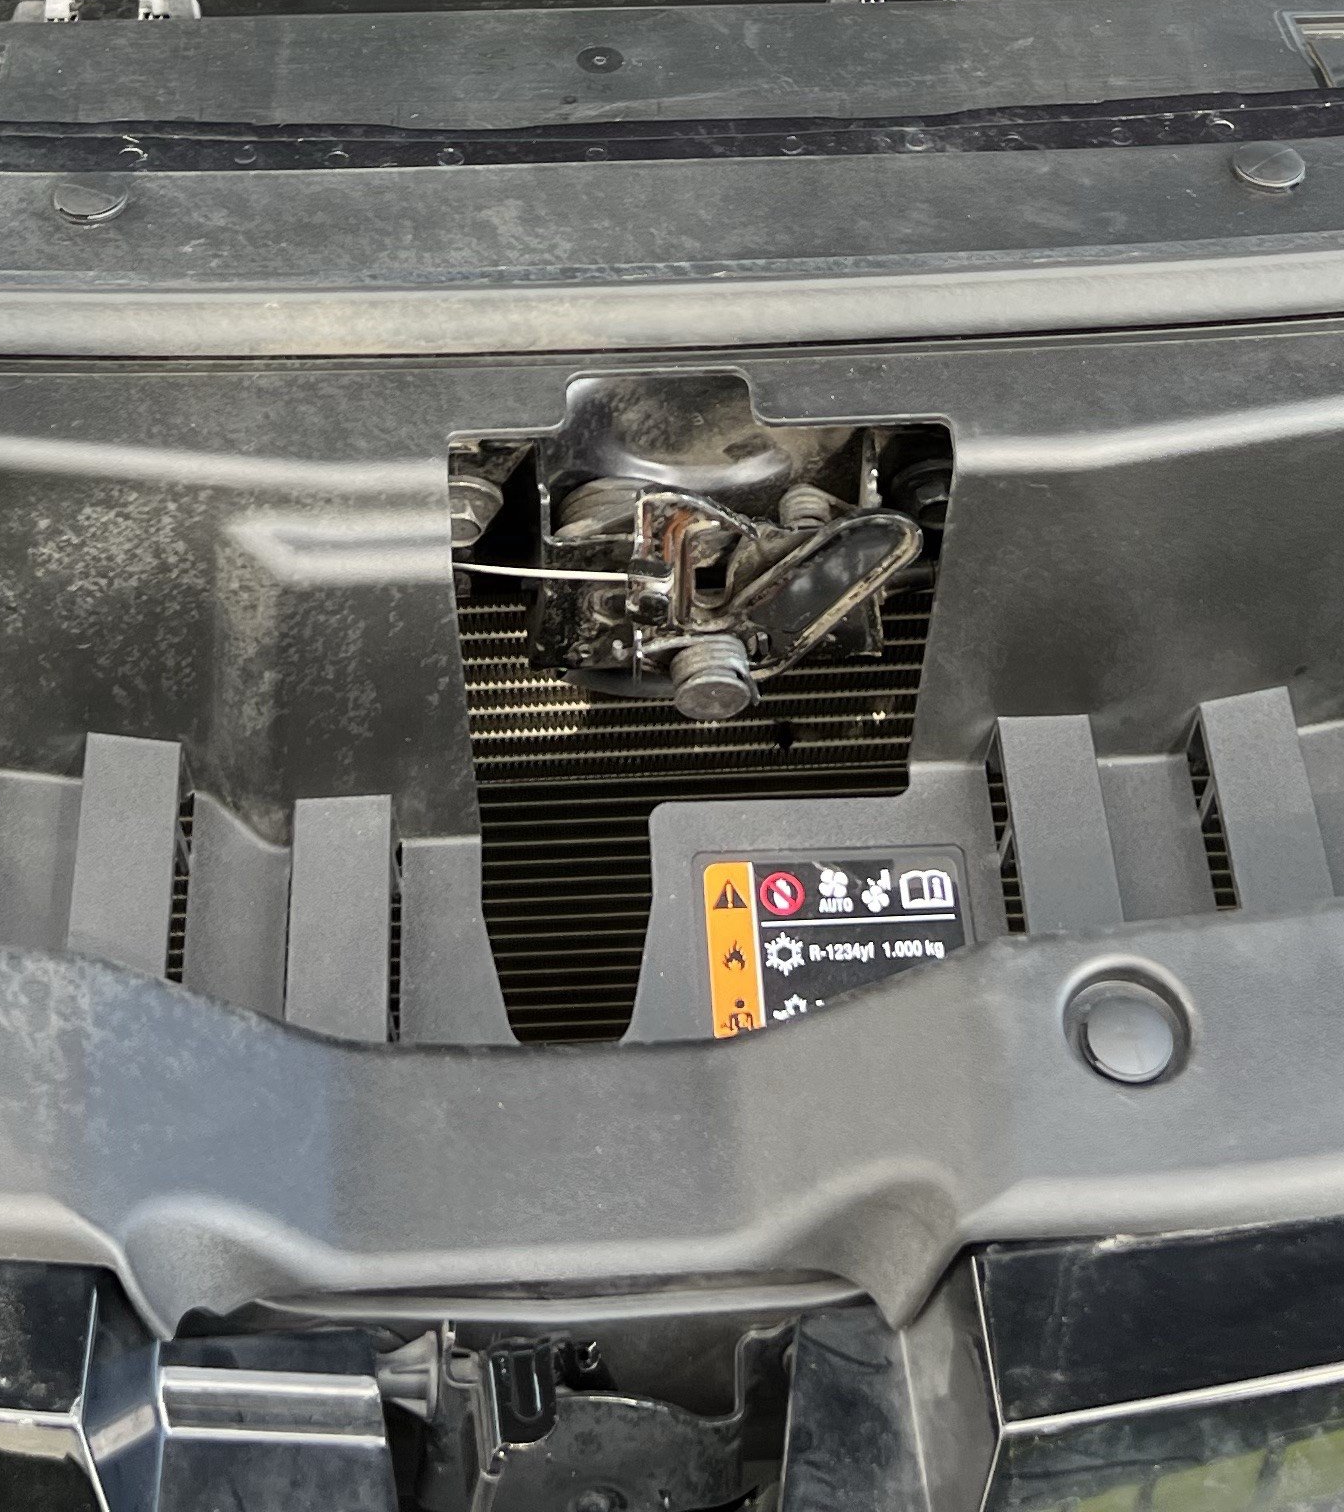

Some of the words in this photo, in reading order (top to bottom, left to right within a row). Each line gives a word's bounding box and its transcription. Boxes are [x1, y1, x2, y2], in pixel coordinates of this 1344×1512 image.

[819, 896, 854, 914] AUTO
[808, 941, 875, 963] R-1234yf
[882, 939, 923, 959] 1.000
[925, 939, 946, 959] kg
